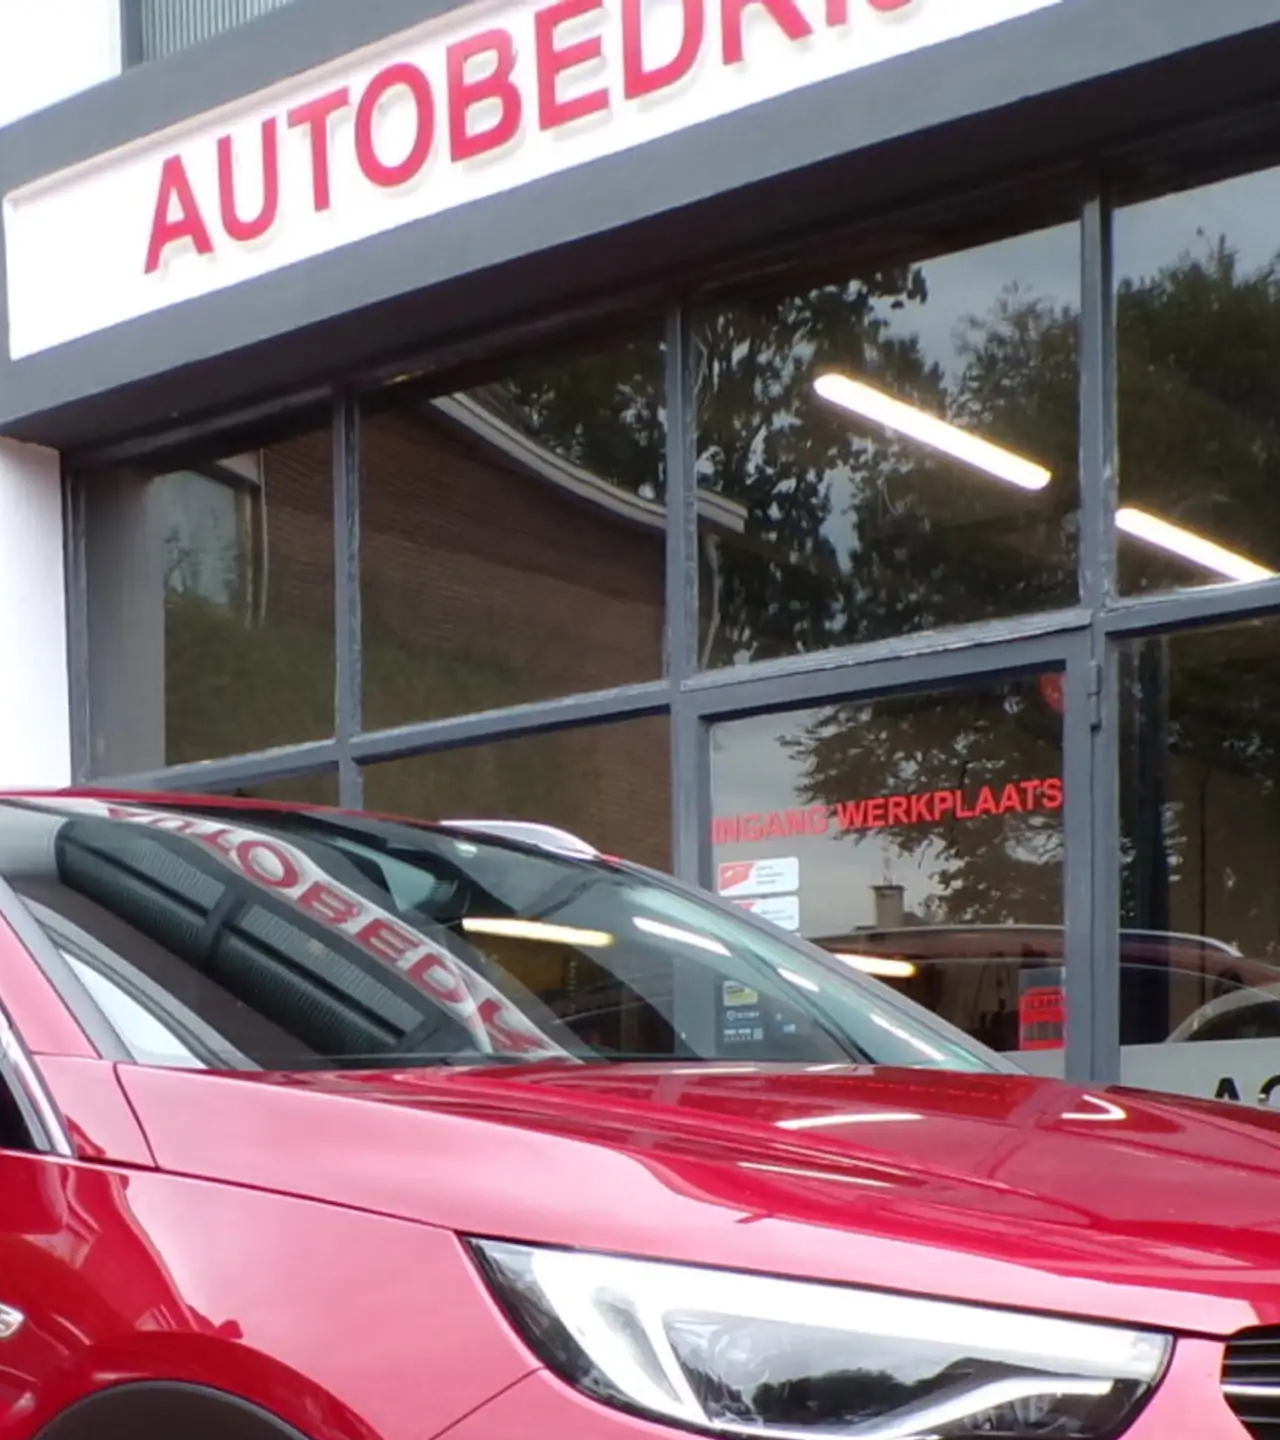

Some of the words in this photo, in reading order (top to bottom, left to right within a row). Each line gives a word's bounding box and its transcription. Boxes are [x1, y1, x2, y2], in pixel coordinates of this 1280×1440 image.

[144, 0, 914, 274] AUTOBED
[710, 806, 828, 845] INGANG
[834, 778, 1063, 831] WERKPLAATS
